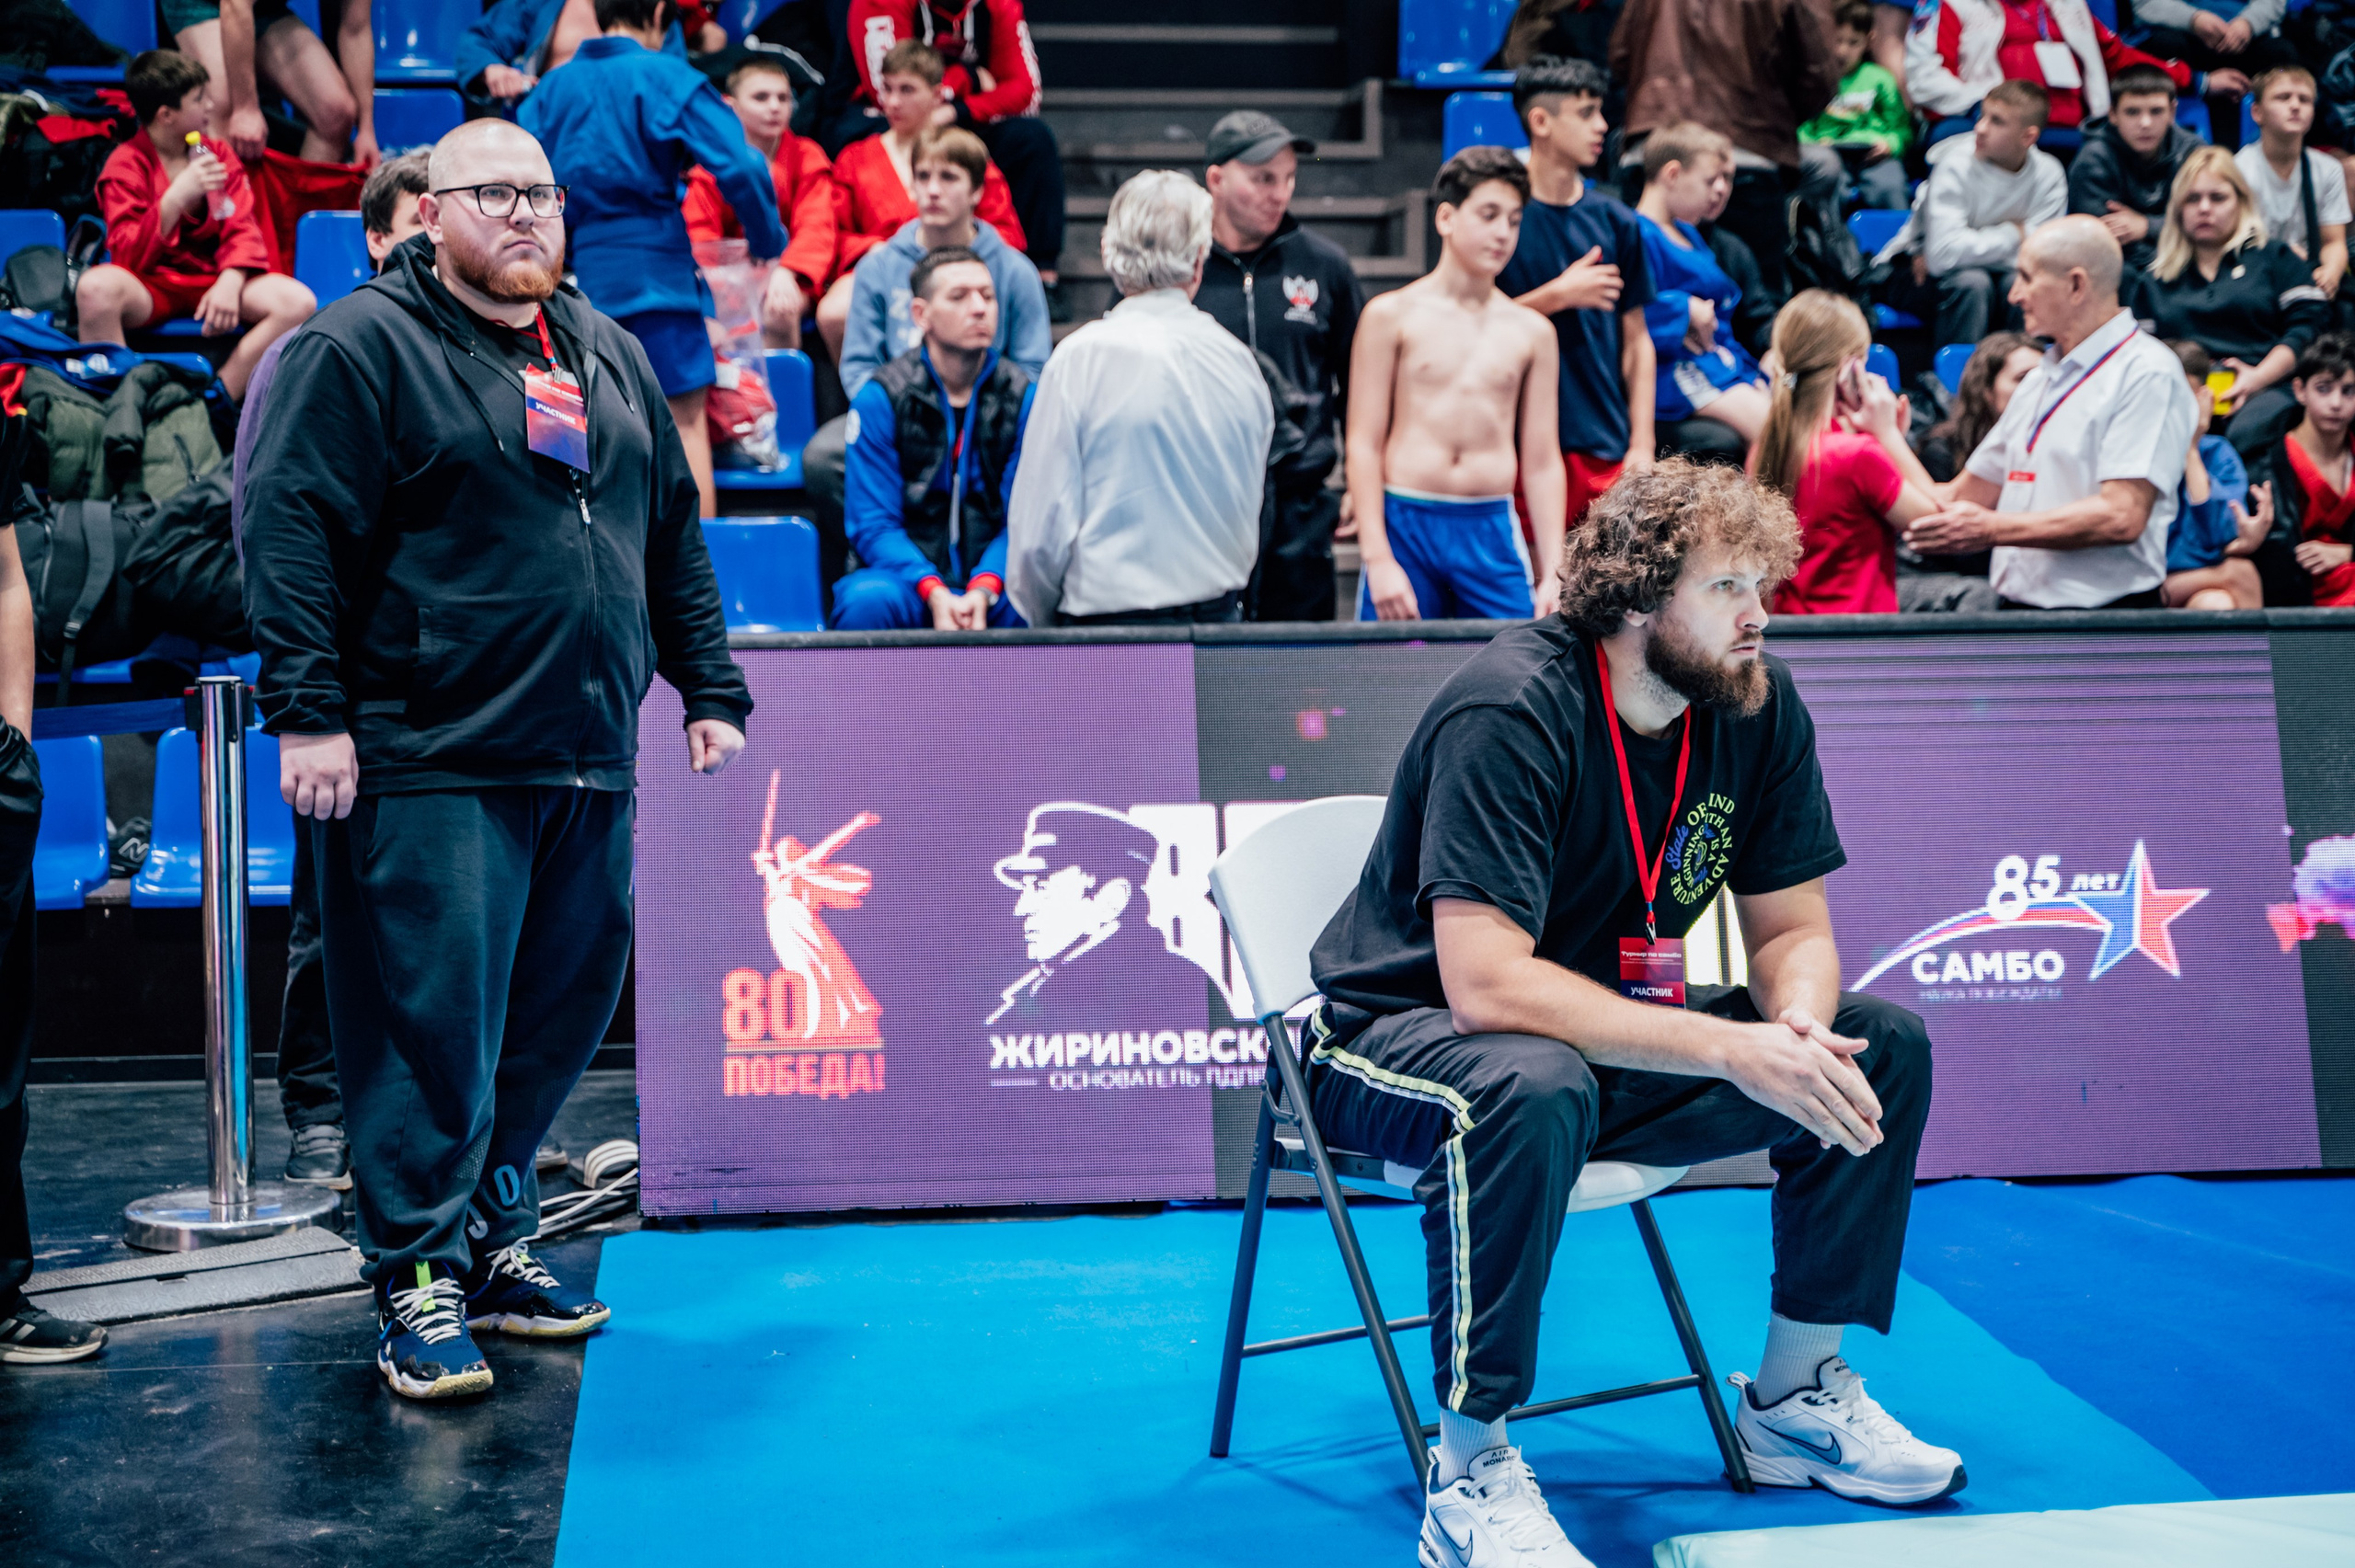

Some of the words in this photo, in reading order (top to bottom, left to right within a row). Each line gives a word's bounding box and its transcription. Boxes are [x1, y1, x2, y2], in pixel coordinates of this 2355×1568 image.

[1665, 825, 1689, 870] State
[1687, 802, 1707, 826] OF
[1707, 792, 1735, 814] IND
[1704, 812, 1726, 829] ITH
[1683, 824, 1704, 888] EGINNING
[1671, 853, 1729, 905] ADVENTURE
[1985, 854, 2062, 921] 85
[1912, 950, 2065, 984] САМБО
[722, 967, 809, 1041] 80
[1630, 987, 1673, 998] УЧАСТНИК
[990, 1027, 1302, 1069] ЖИРИНОВСК
[724, 1054, 885, 1099] ПОБЕДА!
[1482, 1455, 1517, 1468] MONARC
[1491, 1449, 1509, 1458] AIR
